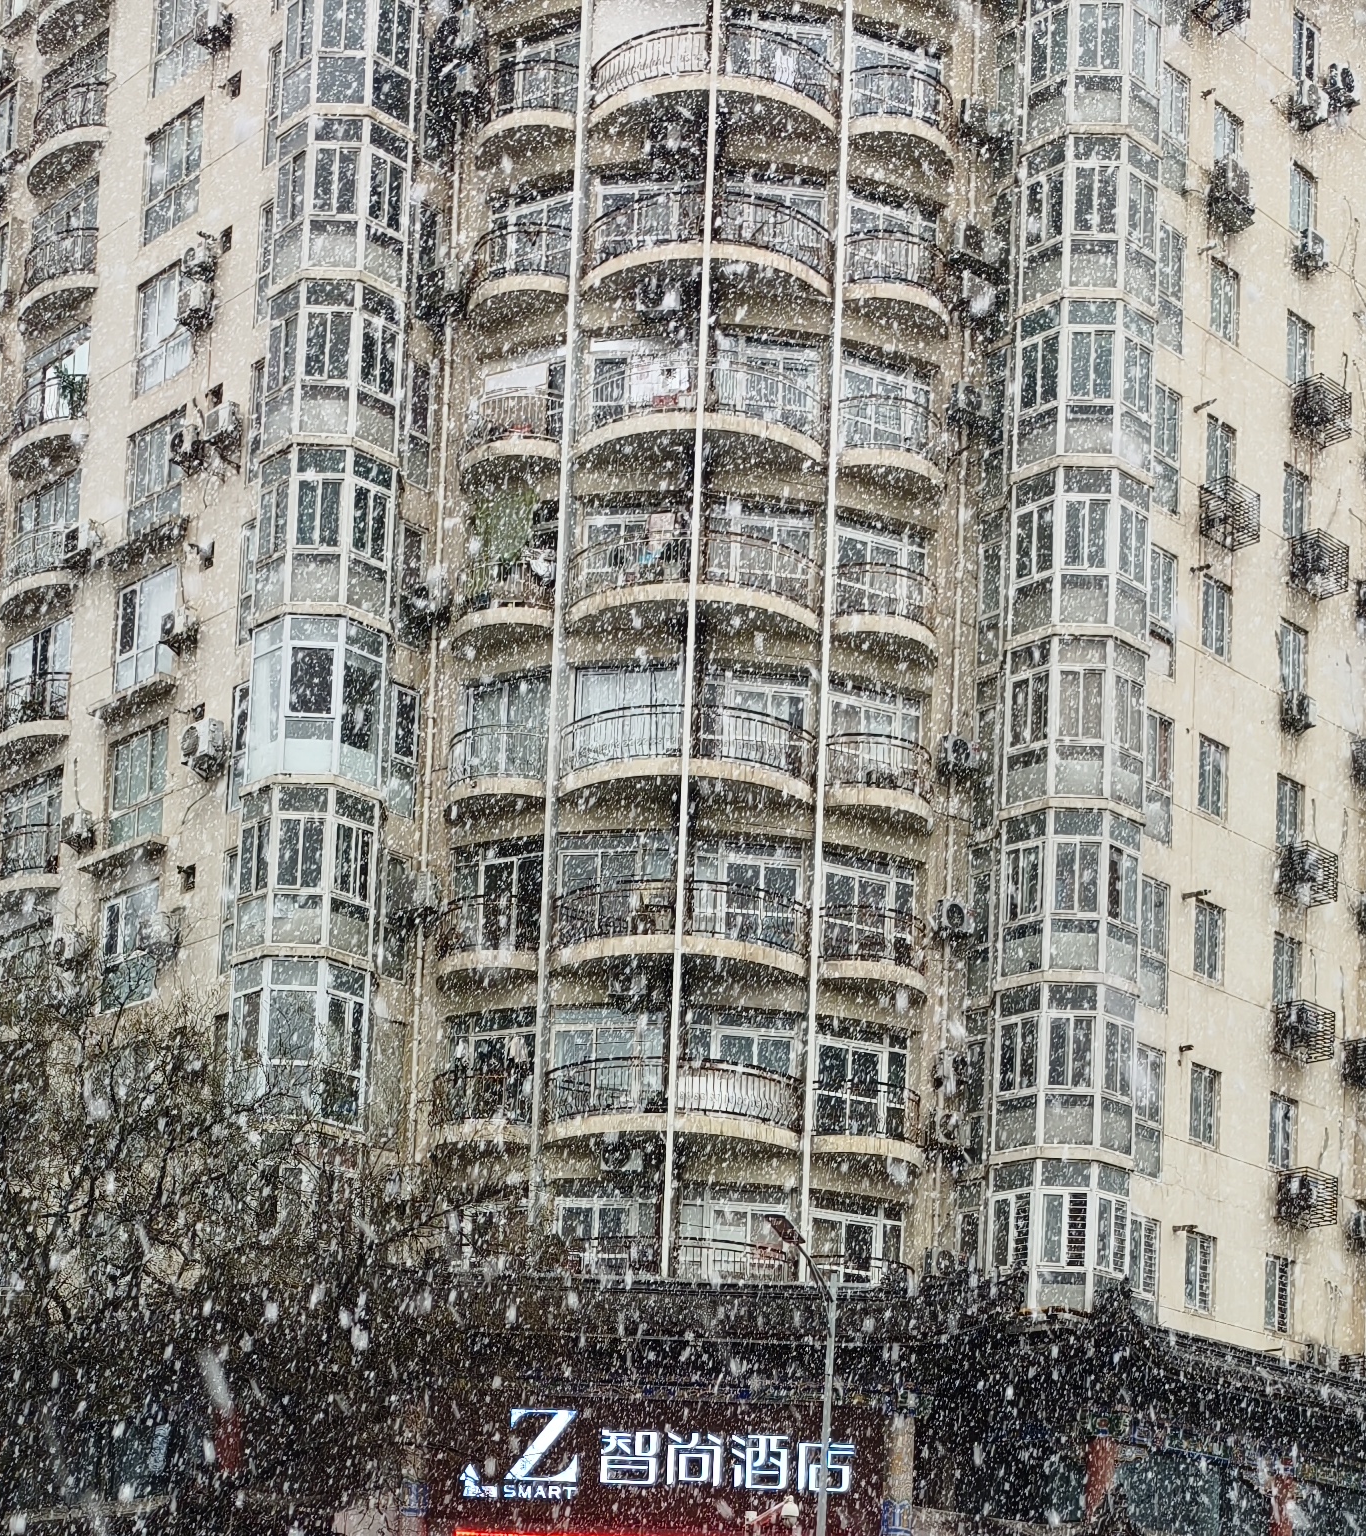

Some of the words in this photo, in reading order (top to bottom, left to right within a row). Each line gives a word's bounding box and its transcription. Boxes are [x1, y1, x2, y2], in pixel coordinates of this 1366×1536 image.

[599, 1429, 855, 1493] 智尚酒店
[503, 1485, 577, 1499] SMART
